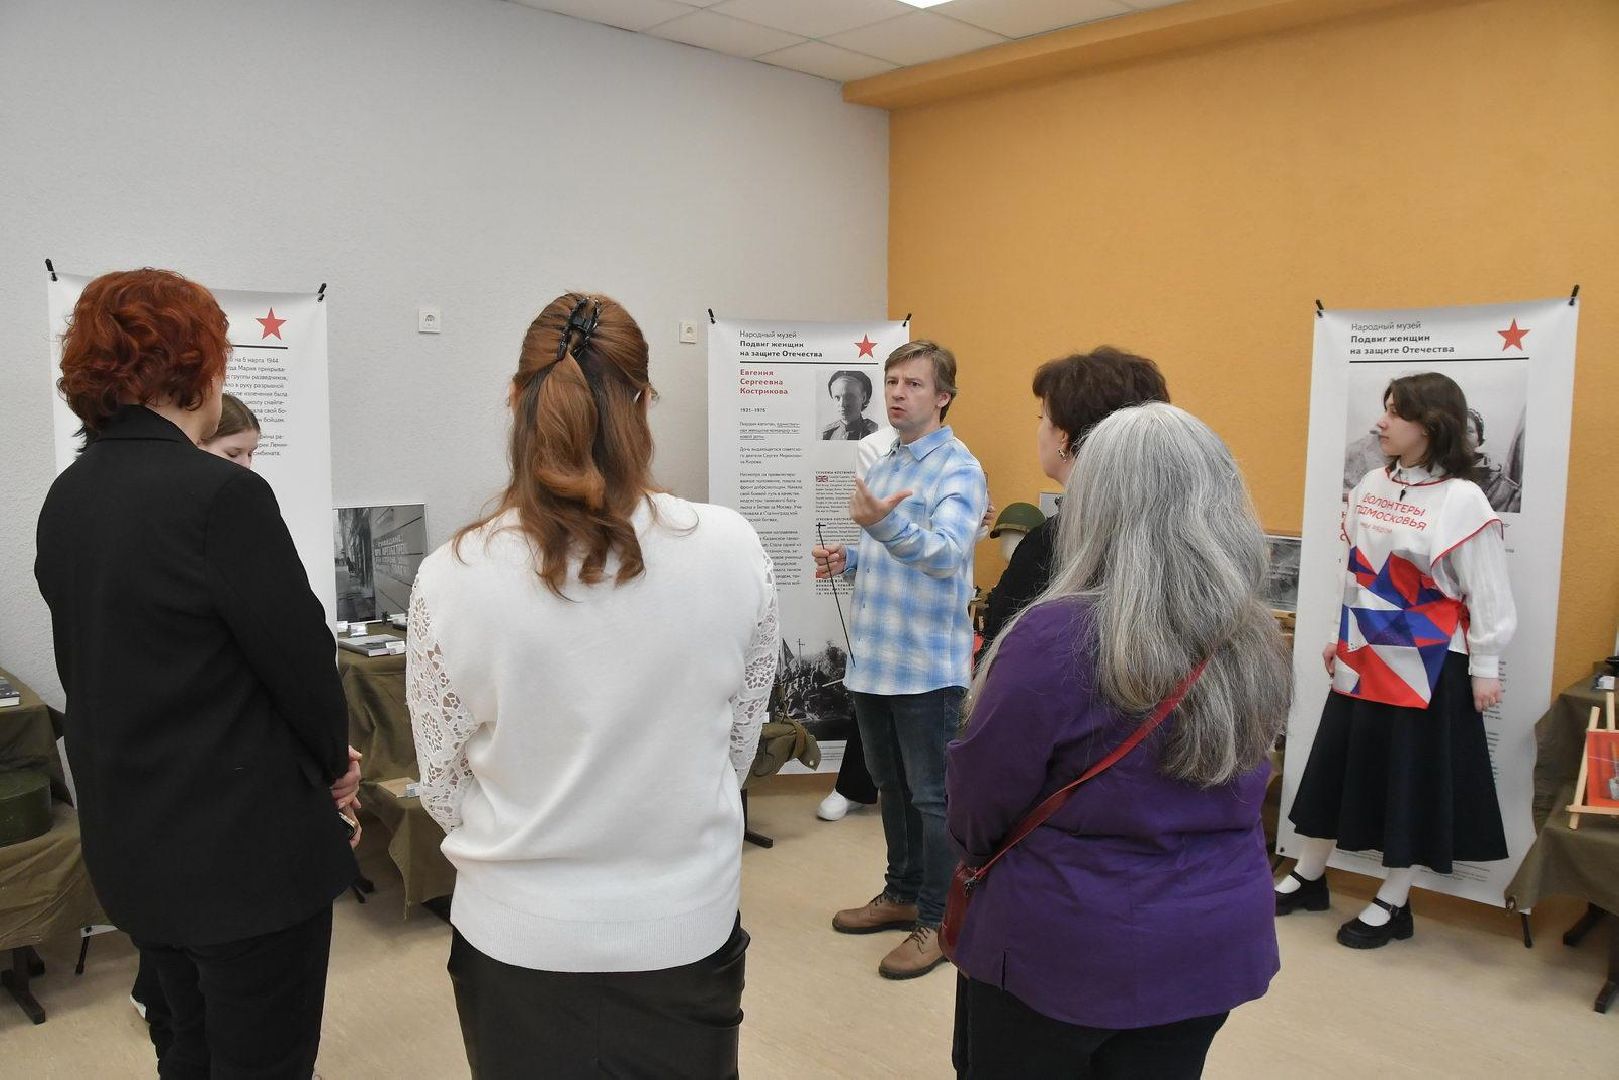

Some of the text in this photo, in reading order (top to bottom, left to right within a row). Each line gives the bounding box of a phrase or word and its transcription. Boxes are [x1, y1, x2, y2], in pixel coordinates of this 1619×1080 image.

[1351, 320, 1421, 333] Народный музей
[740, 331, 797, 340] Народный музей
[1351, 334, 1431, 344] Подвиг женщин
[740, 340, 769, 348] Подвиг
[751, 350, 781, 358] защите
[782, 349, 823, 358] Отечества
[1350, 345, 1455, 355] на защите Отечества
[740, 378, 783, 386] Сергеевна
[740, 388, 788, 396] Кострикова
